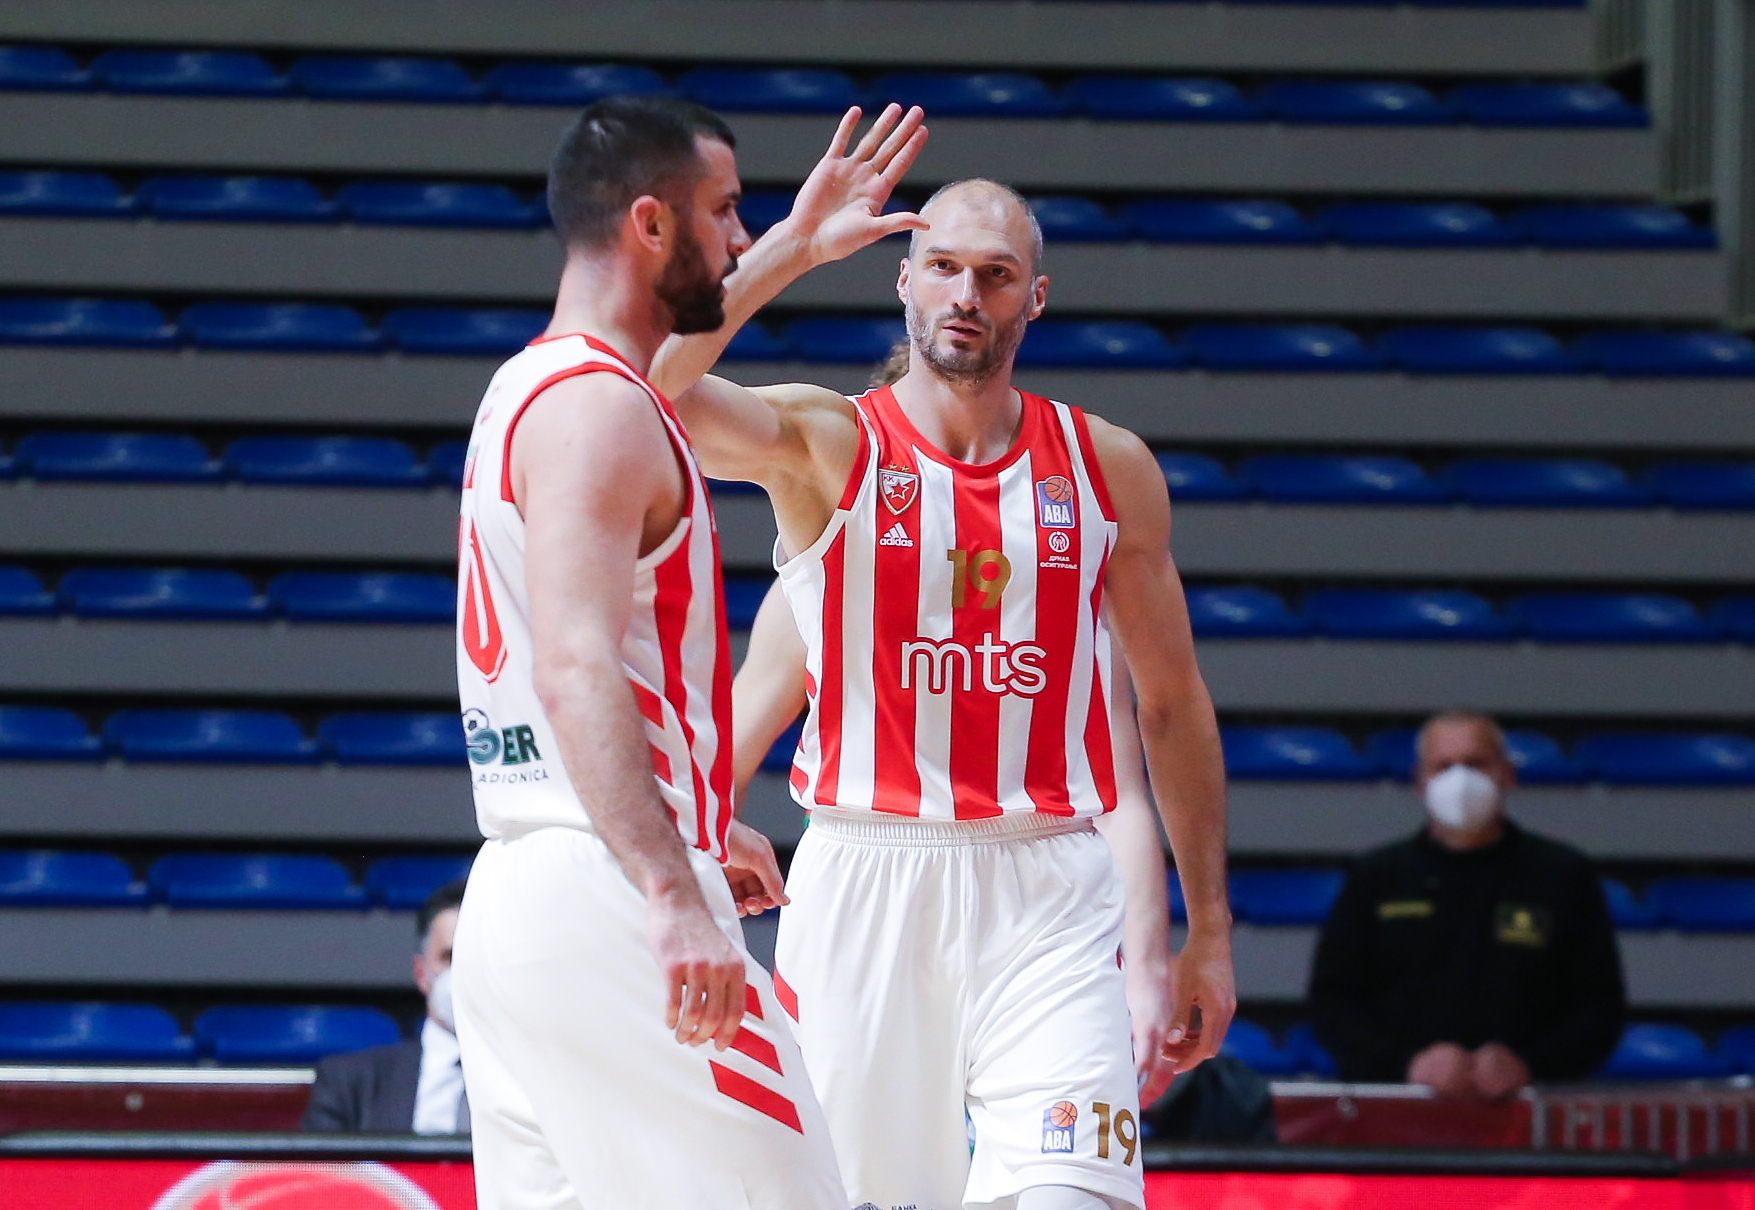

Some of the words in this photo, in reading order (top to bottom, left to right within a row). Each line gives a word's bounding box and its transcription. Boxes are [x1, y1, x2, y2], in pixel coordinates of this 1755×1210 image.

[1044, 504, 1071, 523] ABA
[880, 537, 914, 547] adidas
[947, 549, 1012, 610] 19
[901, 632, 1048, 694] mts
[473, 769, 549, 790] ADIONICA
[1043, 1130, 1072, 1151] ABA
[1092, 1101, 1137, 1166] 19
